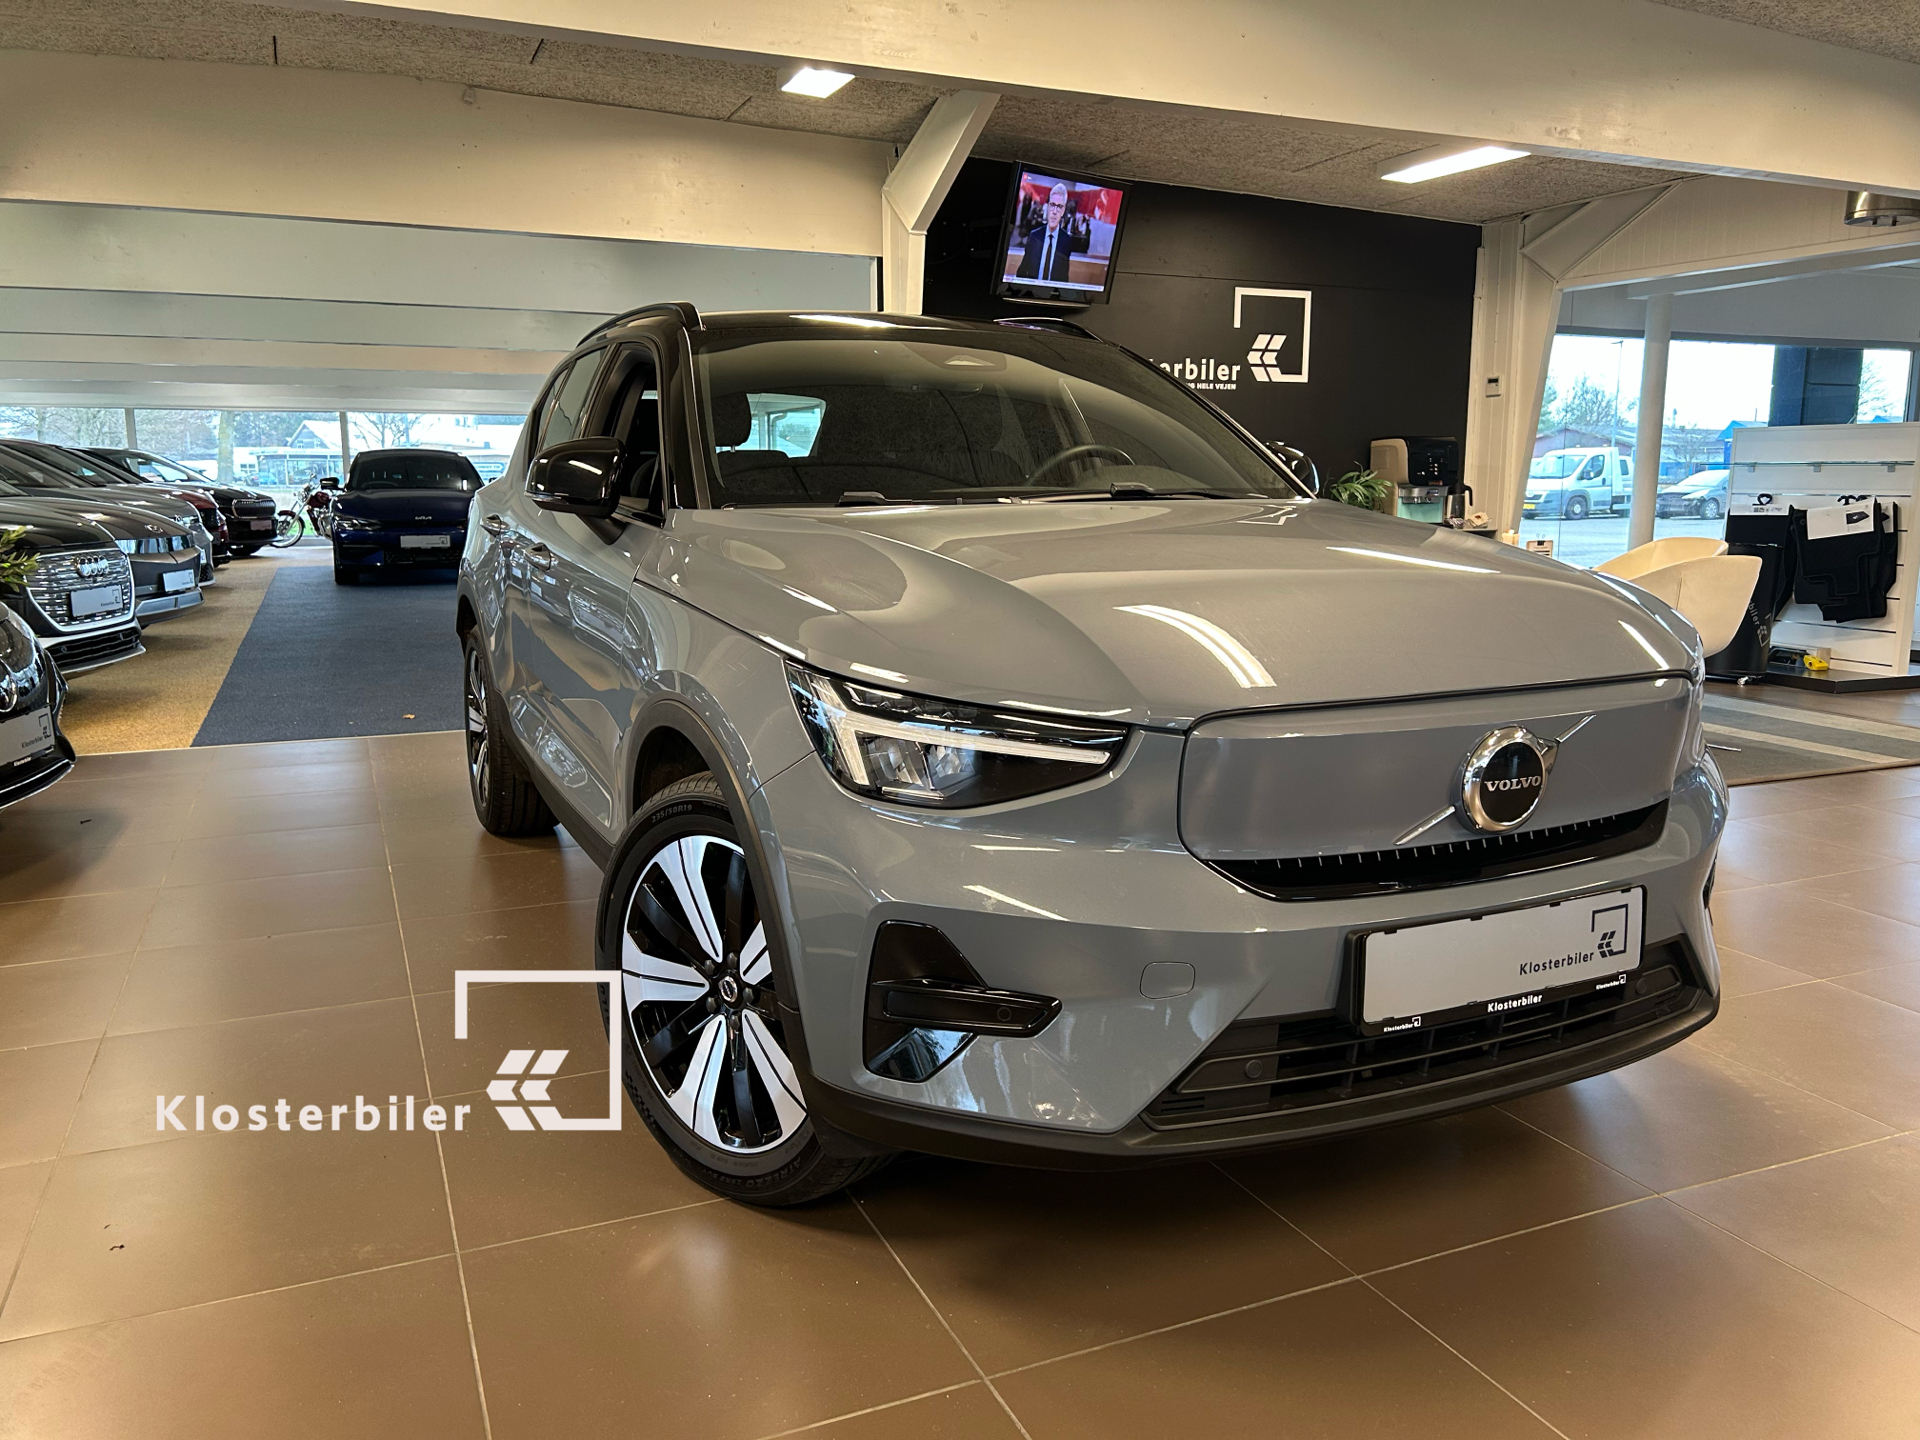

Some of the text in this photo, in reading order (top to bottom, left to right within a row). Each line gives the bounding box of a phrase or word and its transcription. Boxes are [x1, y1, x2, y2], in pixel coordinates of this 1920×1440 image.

[1484, 775, 1542, 792] VOLVO
[651, 804, 693, 823] 235/50R19
[1519, 951, 1594, 975] Klosterbiler
[1487, 994, 1543, 1013] Klosterbiler
